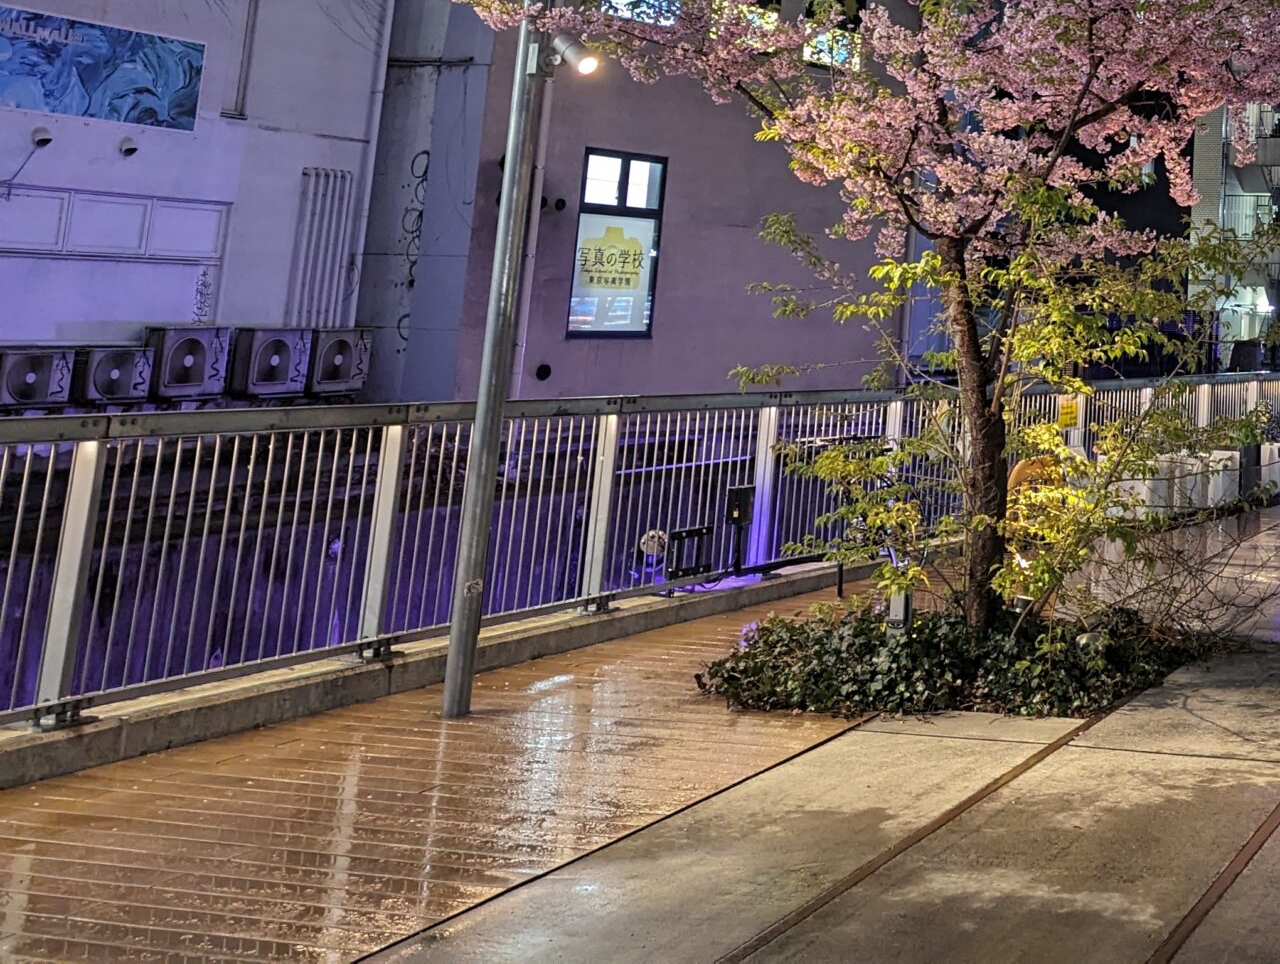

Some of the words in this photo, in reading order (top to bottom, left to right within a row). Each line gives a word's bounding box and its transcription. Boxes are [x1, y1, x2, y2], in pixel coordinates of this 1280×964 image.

[577, 247, 645, 269] 写真の学校
